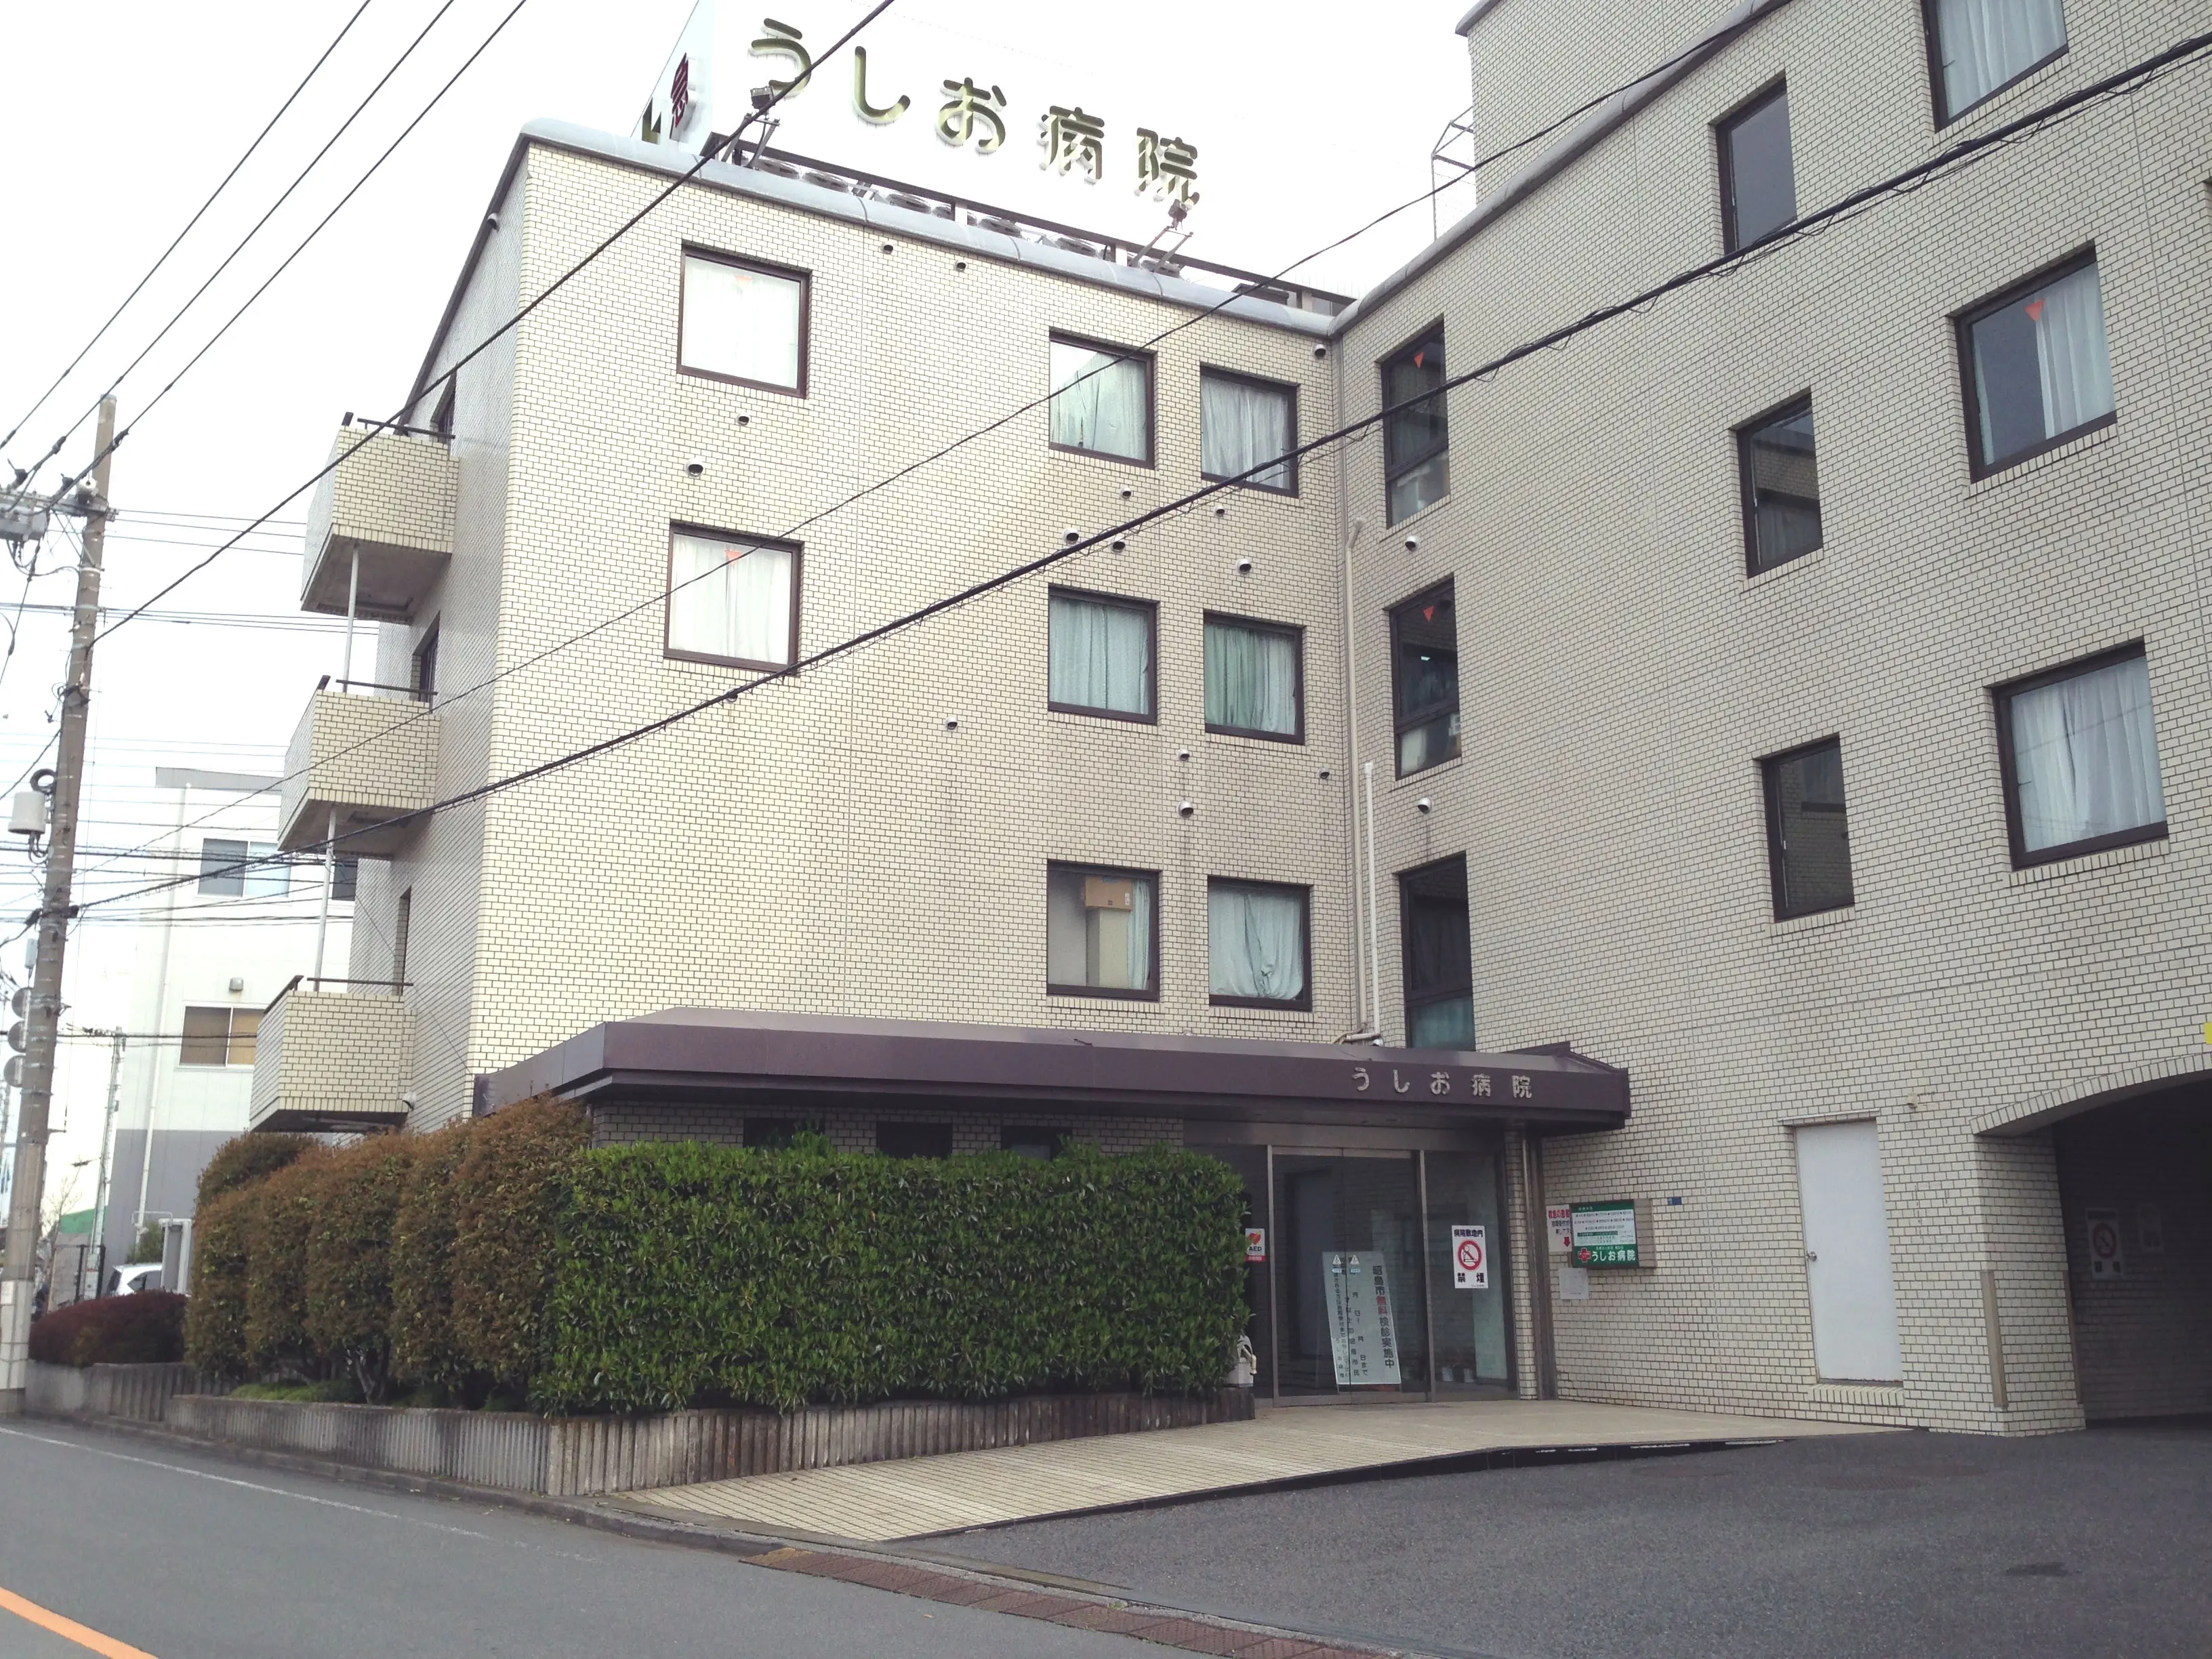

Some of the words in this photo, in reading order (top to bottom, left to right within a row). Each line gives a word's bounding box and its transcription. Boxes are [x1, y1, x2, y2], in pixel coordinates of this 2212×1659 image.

[748, 18, 1198, 205] うしお病院
[1353, 1067, 1533, 1099] うしお病院
[1592, 1250, 1635, 1261] うしお病院
